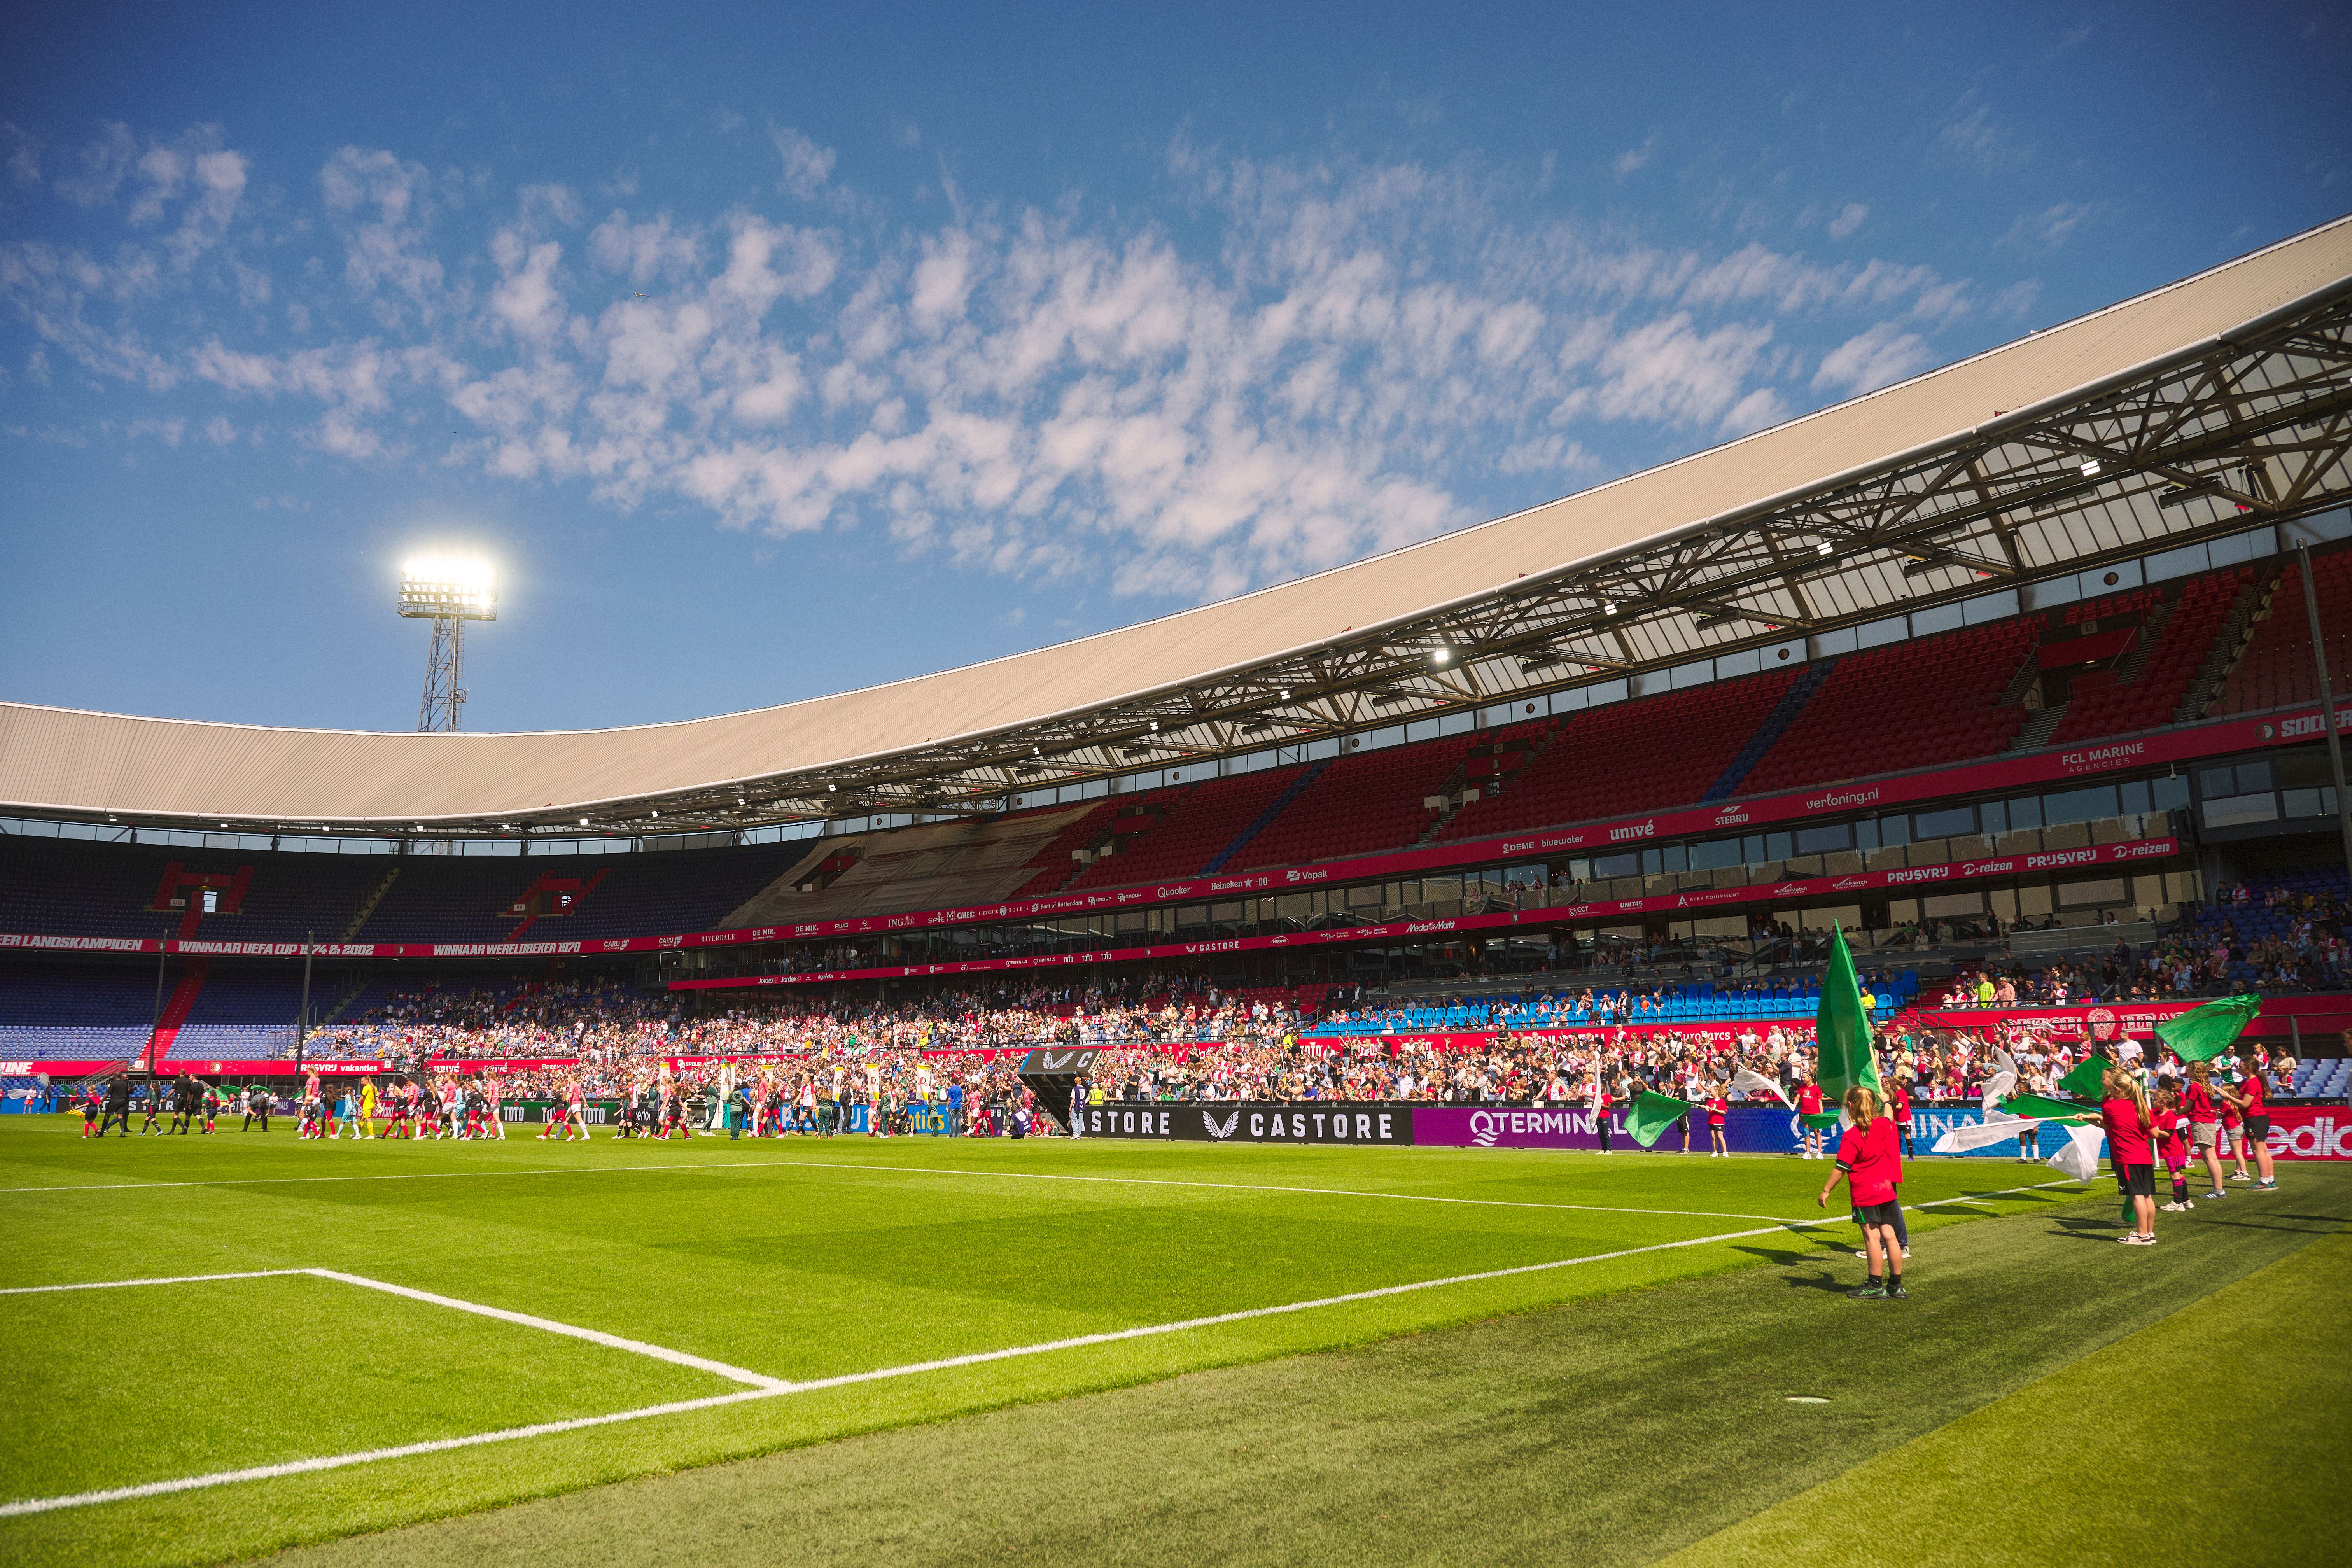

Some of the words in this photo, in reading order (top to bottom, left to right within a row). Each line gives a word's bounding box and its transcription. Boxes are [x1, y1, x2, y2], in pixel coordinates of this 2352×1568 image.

[2062, 753, 2086, 765] FCL
[2089, 743, 2144, 761] MARINE
[2069, 758, 2130, 773] AGENCIES
[1806, 788, 1879, 809] verloning.nl
[1715, 813, 1748, 826] STEBRU
[1610, 819, 1654, 840] univé
[1510, 842, 1534, 851] DEME
[1541, 836, 1583, 847] bluewater
[2113, 843, 2170, 858] D-reizen
[2027, 850, 2096, 867] PRIJSVRIJ
[1302, 870, 1327, 880] Vopak
[1888, 867, 1948, 883] PRIJSVRIJ
[1963, 862, 2012, 875] D-reizen
[1158, 886, 1191, 898] Quooker
[1211, 880, 1242, 890] Heineken
[888, 918, 903, 927] ING
[22, 936, 143, 950] LANDSKAMPIOEN
[701, 934, 735, 942] RIVERDALE
[178, 941, 243, 953] WINNAAR
[243, 943, 273, 954] UEFA
[275, 944, 298, 954] CUP
[342, 945, 374, 955] 2002
[434, 945, 486, 955] WINNAAR
[486, 943, 557, 955] WERELDBEKER
[558, 942, 581, 952] 1970
[1200, 941, 1239, 952] CASTORE
[1077, 1052, 1093, 1068] C
[504, 1106, 524, 1122] TOTO
[583, 1107, 605, 1124] TOTO
[1251, 1113, 1392, 1139] CASTORE
